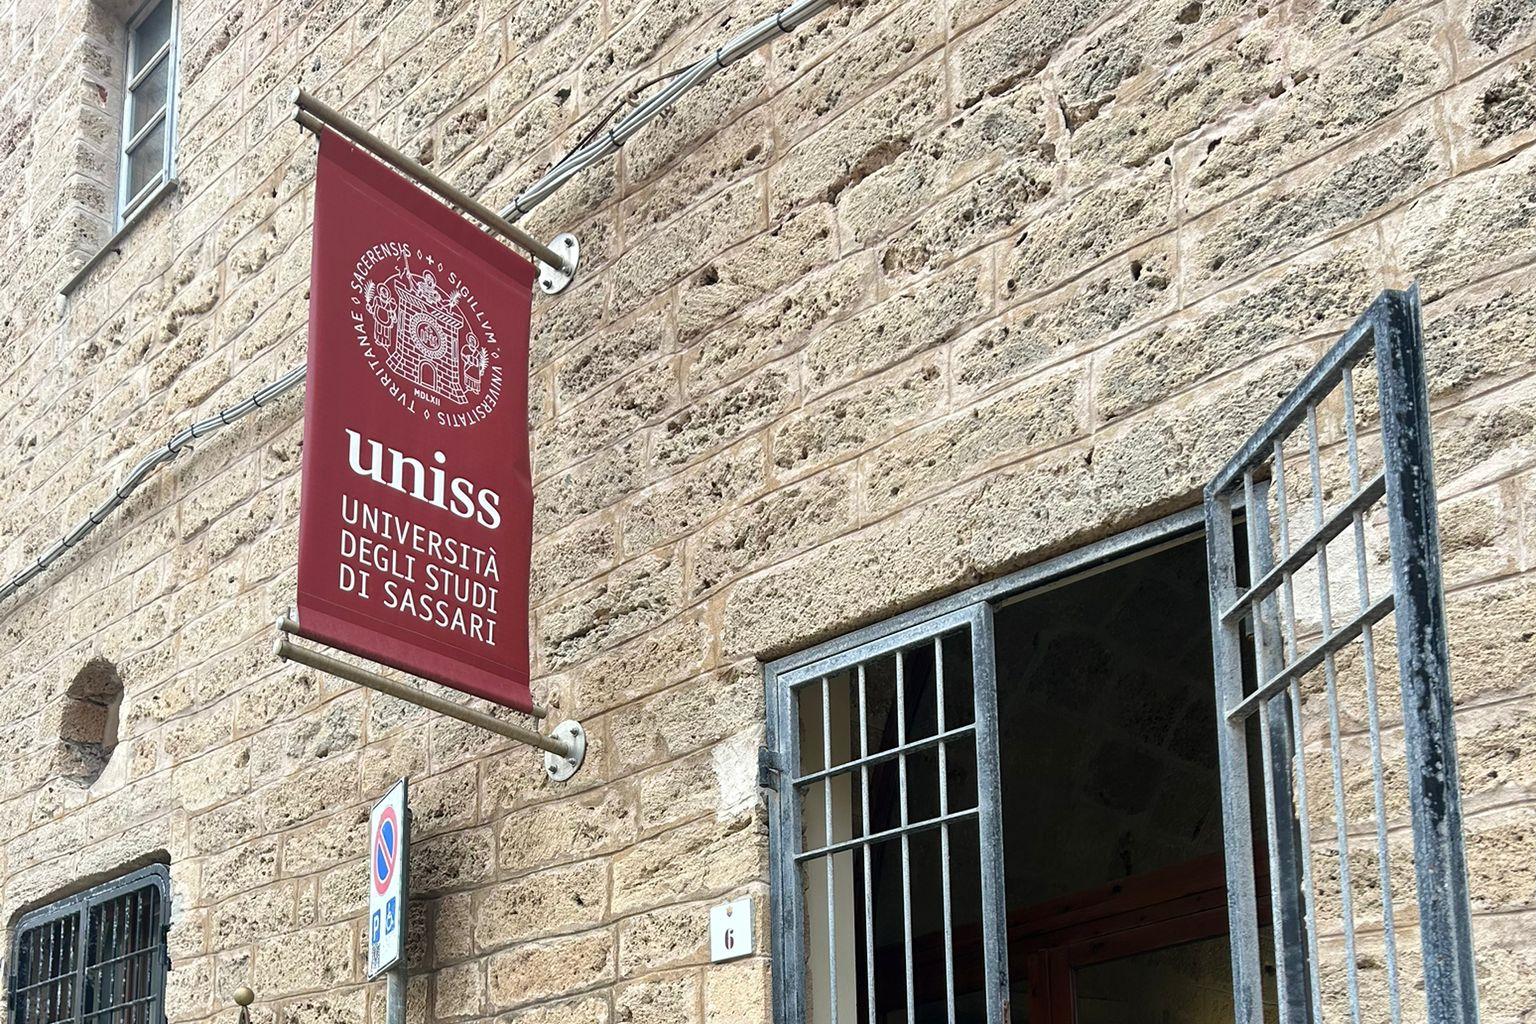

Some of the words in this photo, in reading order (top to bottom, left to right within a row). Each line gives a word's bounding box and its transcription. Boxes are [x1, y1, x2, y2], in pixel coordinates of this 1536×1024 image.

[351, 241, 412, 294] SACERENSIS
[448, 271, 497, 344] SIGILLVM
[351, 310, 416, 414] TVRRITANAE
[414, 388, 441, 407] MDLXII
[437, 366, 503, 428] VNIVERSITATIS
[345, 428, 501, 530] uniss
[340, 529, 416, 583] DEGLI
[425, 563, 499, 615] STUDI
[341, 494, 500, 582] UNIVERSITÀ
[339, 562, 370, 599] DI
[383, 580, 497, 646] SASSARI
[724, 928, 735, 950] 6
